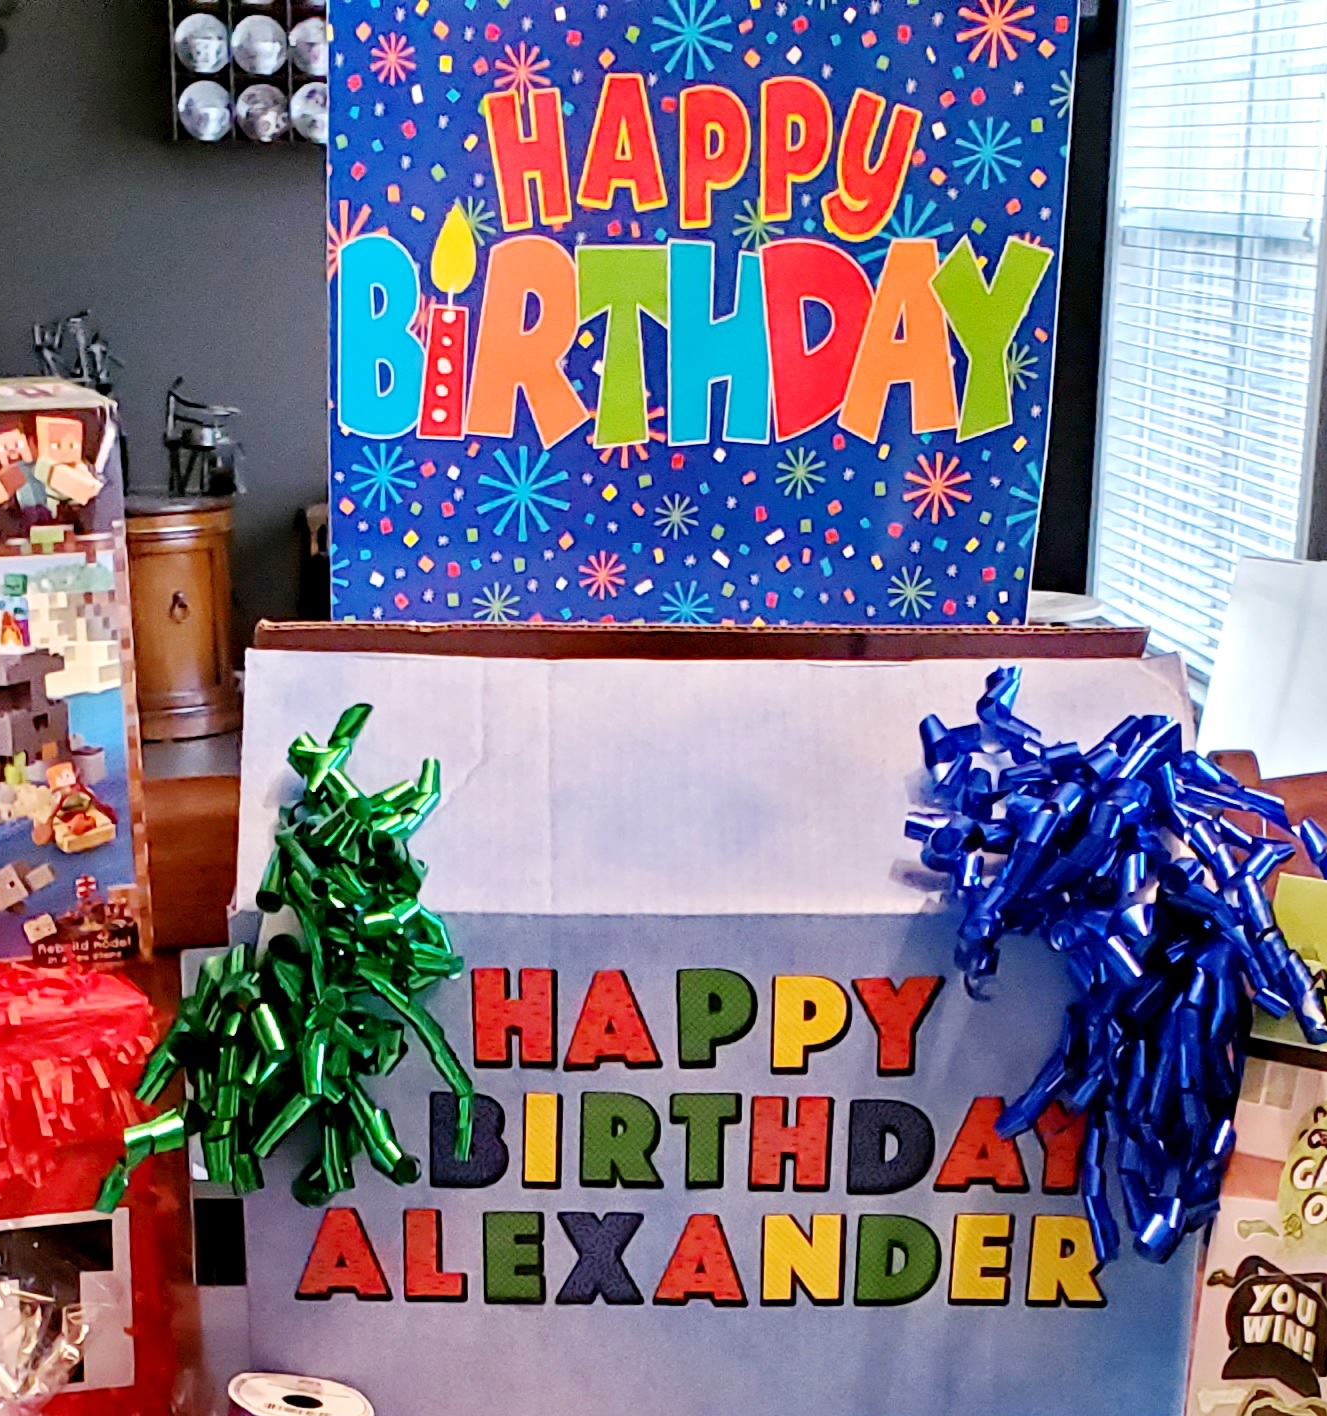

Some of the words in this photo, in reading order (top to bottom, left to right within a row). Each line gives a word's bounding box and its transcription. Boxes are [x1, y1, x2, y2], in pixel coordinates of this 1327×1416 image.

[485, 73, 922, 243] HAPPY
[339, 228, 1054, 448] BIRTHDAY
[473, 967, 943, 1076] HAPPY
[429, 1091, 1088, 1195] BIRTHDAY
[294, 1208, 1107, 1308] ALEXANDER
[1249, 1283, 1317, 1327] YOU
[1243, 1314, 1316, 1362] WIN!
